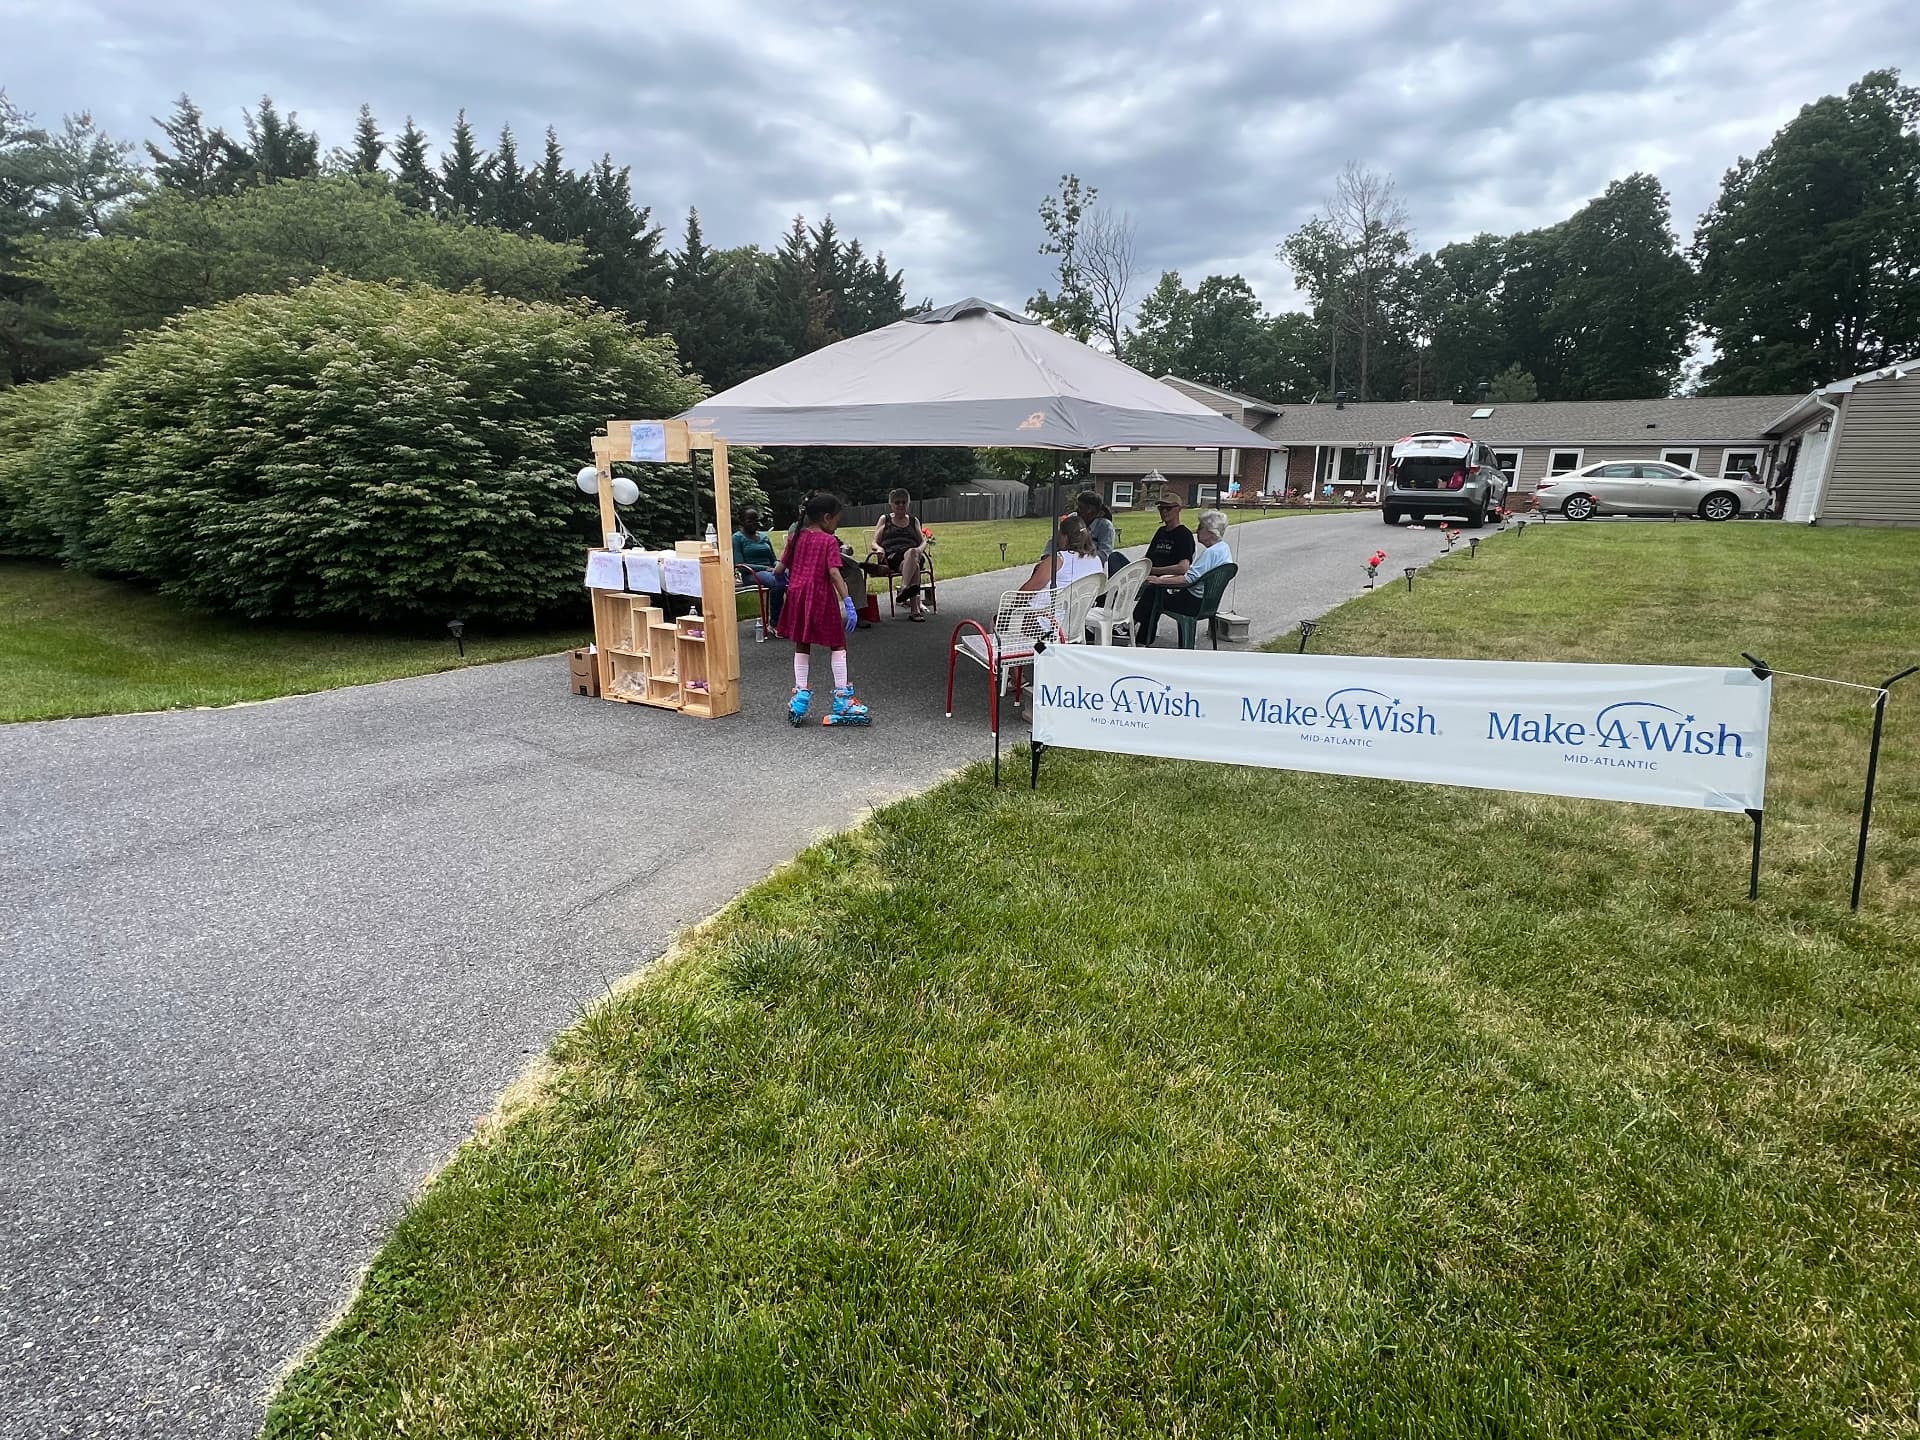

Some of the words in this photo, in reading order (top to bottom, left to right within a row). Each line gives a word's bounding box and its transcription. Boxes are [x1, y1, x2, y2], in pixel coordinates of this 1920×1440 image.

[1090, 717, 1150, 729] MID-ATLANTIC
[1300, 733, 1373, 748] MID-ATLANTIC
[1563, 753, 1658, 771] MID-ATLANTIC
